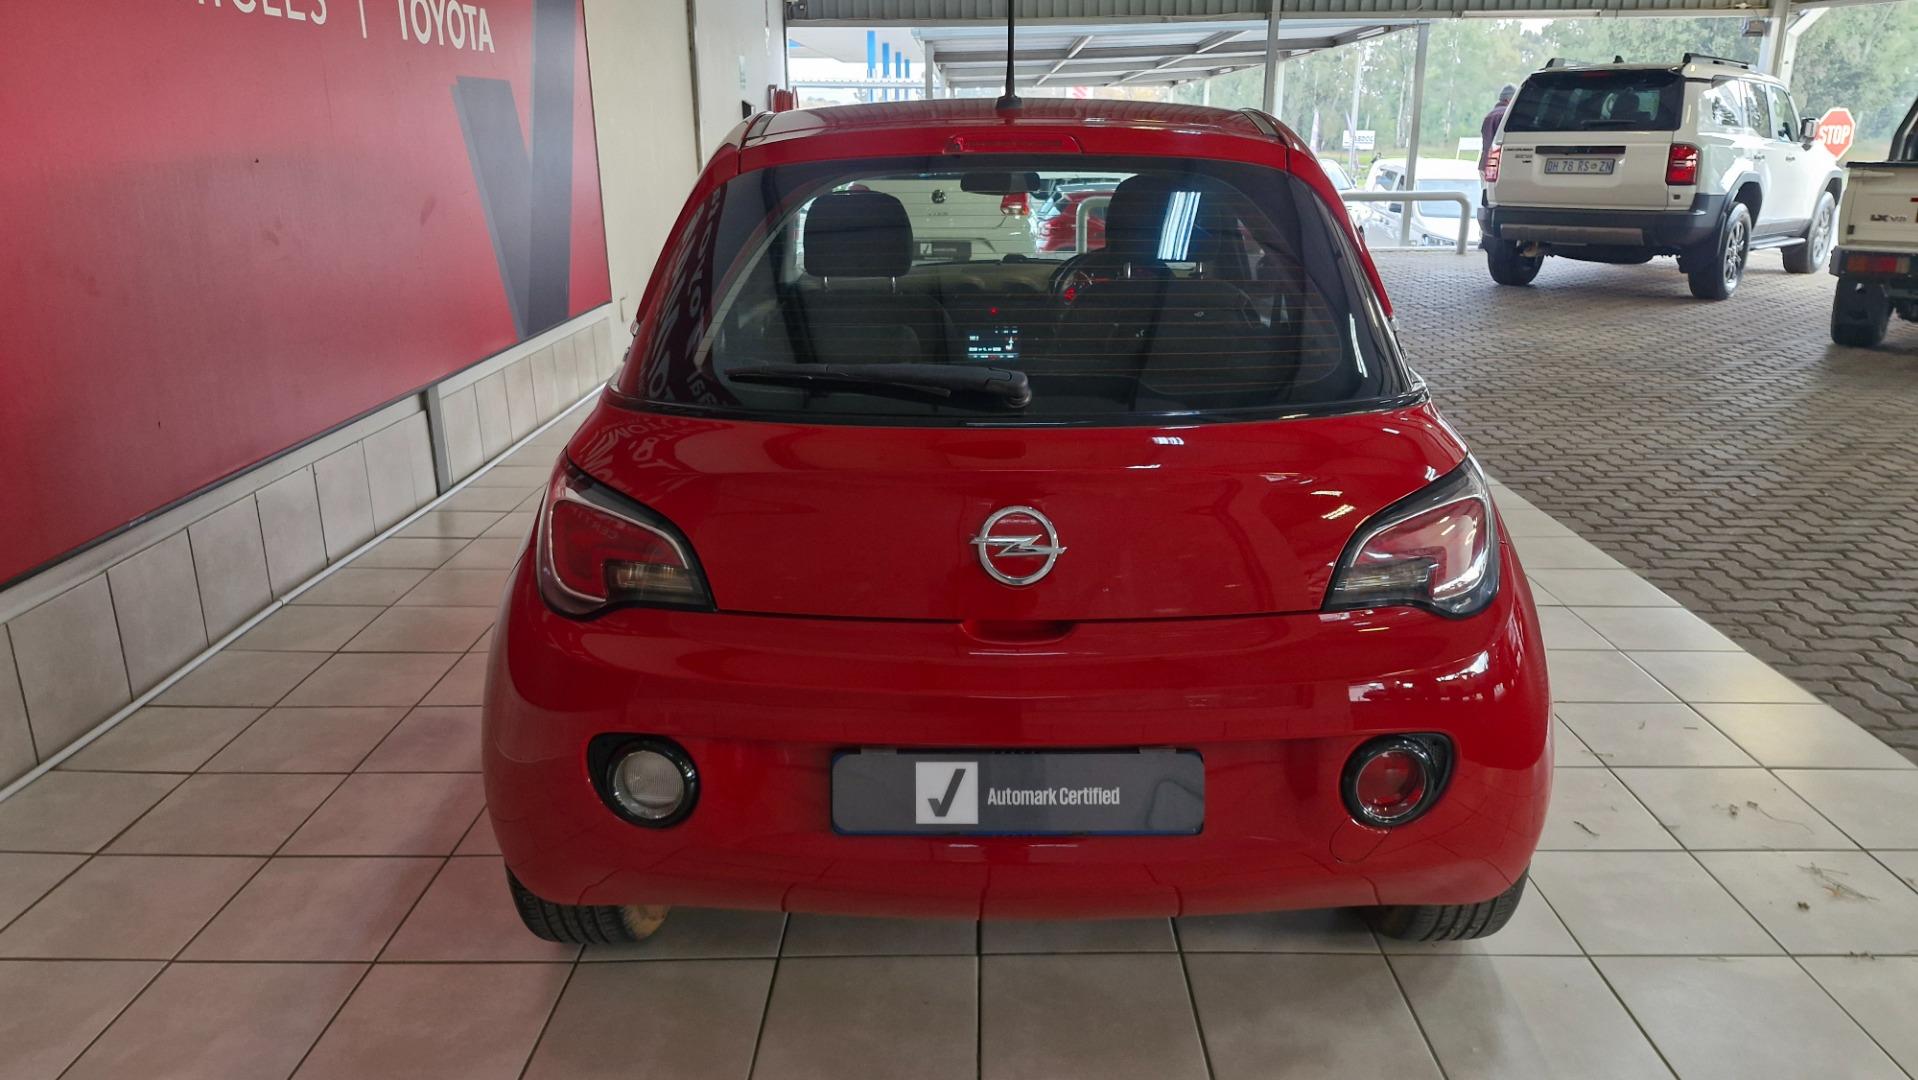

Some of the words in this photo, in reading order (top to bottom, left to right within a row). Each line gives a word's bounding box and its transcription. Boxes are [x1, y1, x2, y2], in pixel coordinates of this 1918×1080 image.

[397, 0, 495, 53] TOYOTA
[1820, 124, 1851, 145] STOP
[1599, 160, 1612, 172] ZN
[988, 787, 1057, 806] Automark
[1059, 786, 1121, 806] Certified
